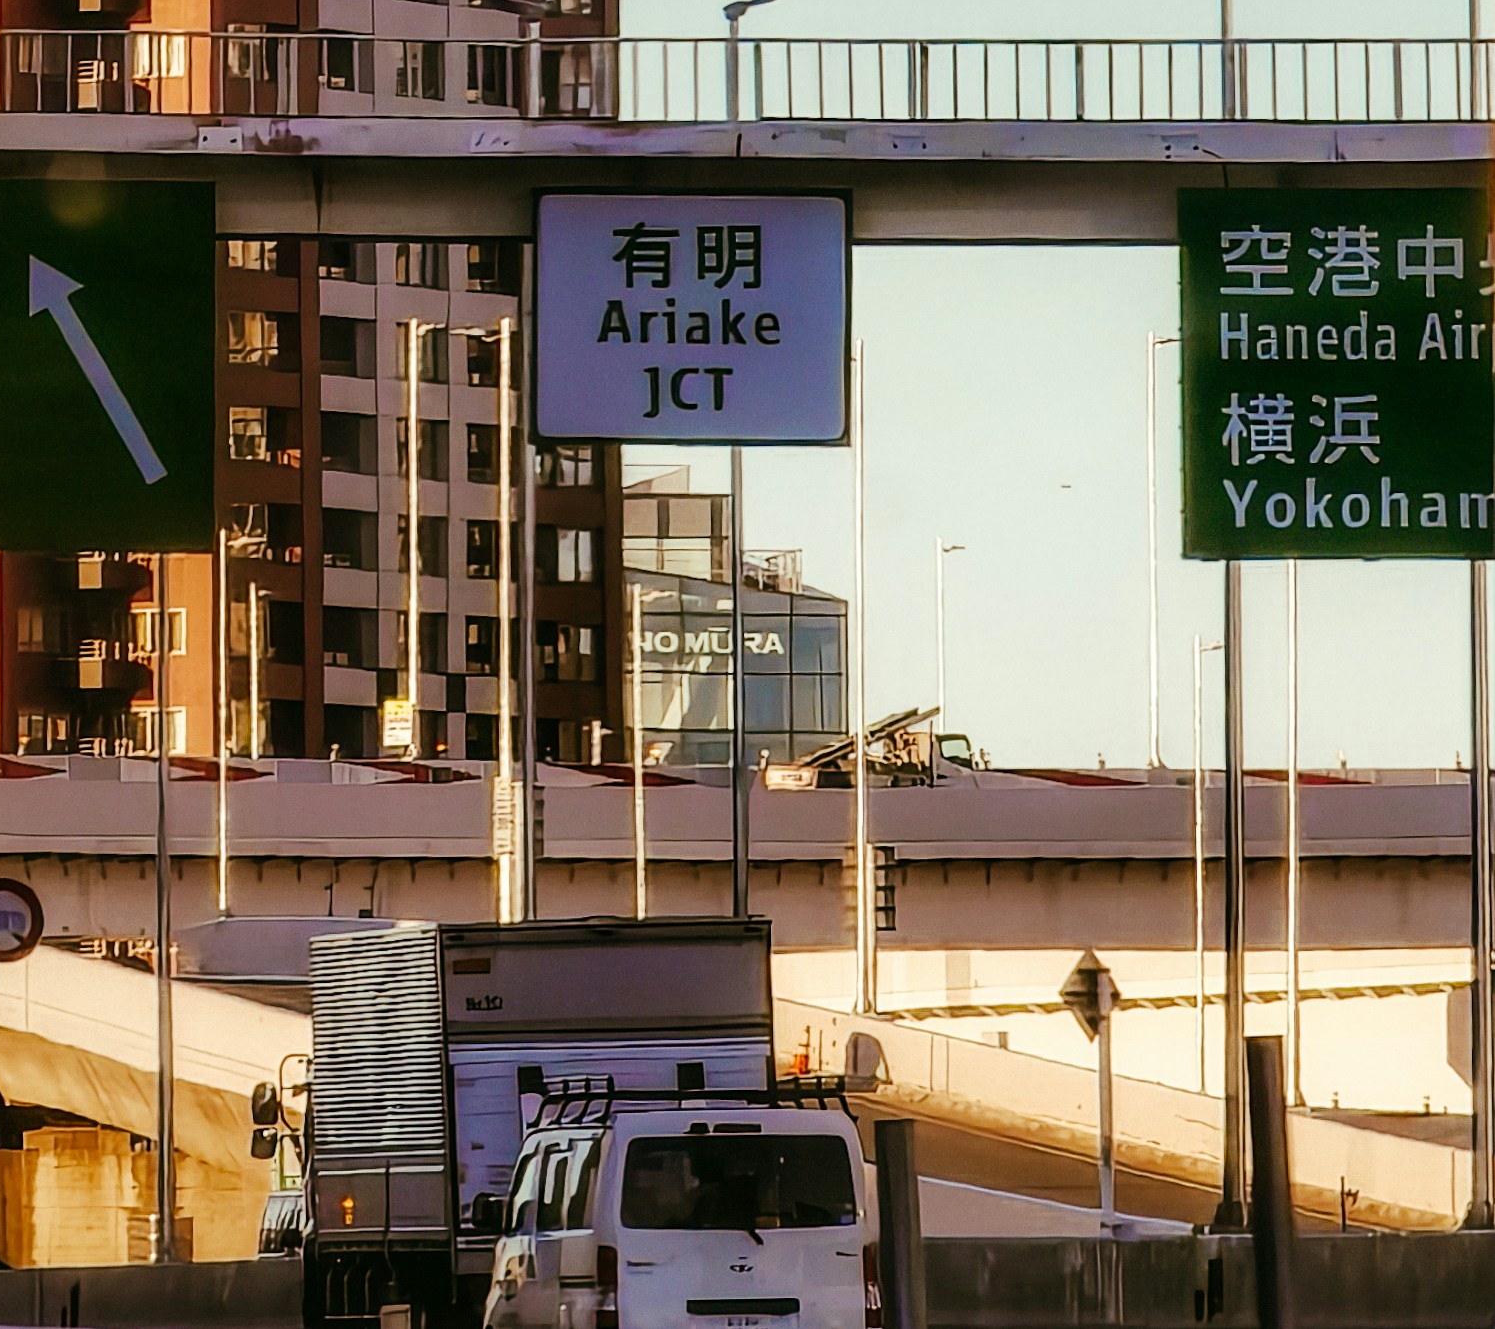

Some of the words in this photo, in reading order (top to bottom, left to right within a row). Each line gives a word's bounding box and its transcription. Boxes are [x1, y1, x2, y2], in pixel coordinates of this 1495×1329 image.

[612, 221, 762, 289] 有明
[597, 298, 781, 345] Ariake
[1219, 310, 1397, 360] Haneda
[642, 366, 734, 419] JCT
[1221, 393, 1381, 466] 横浜
